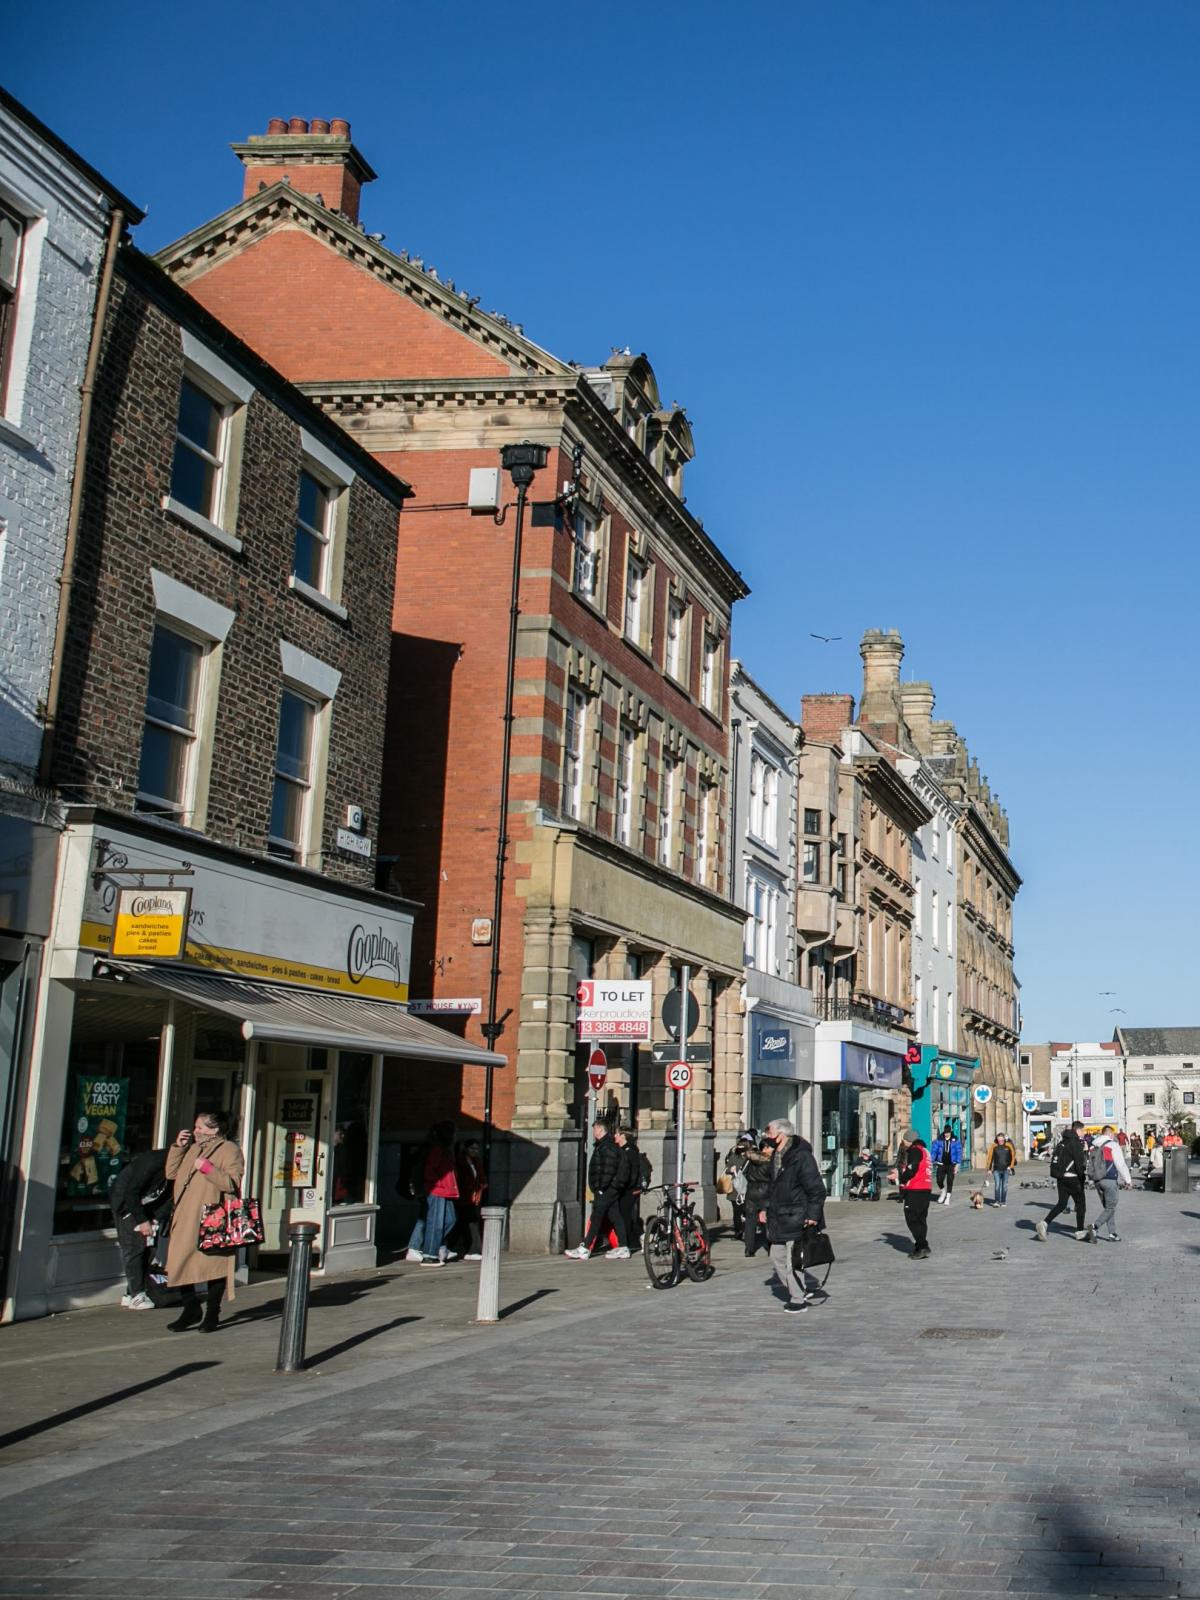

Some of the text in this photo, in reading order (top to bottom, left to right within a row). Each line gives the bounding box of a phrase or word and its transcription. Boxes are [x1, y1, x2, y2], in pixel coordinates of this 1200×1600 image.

[339, 834, 369, 851] HIGH ROW
[131, 896, 174, 917] Cooplands
[347, 924, 400, 988] Cooplands
[600, 991, 645, 1002] TO LET
[583, 1009, 649, 1020] kerproudlove
[595, 1022, 616, 1033] 388
[618, 1022, 646, 1033] 4848
[762, 1036, 787, 1050] Boots
[672, 1069, 689, 1081] 20
[94, 1082, 120, 1094] GOOD
[92, 1094, 120, 1105] TASTY
[85, 1105, 116, 1116] VEGAN
